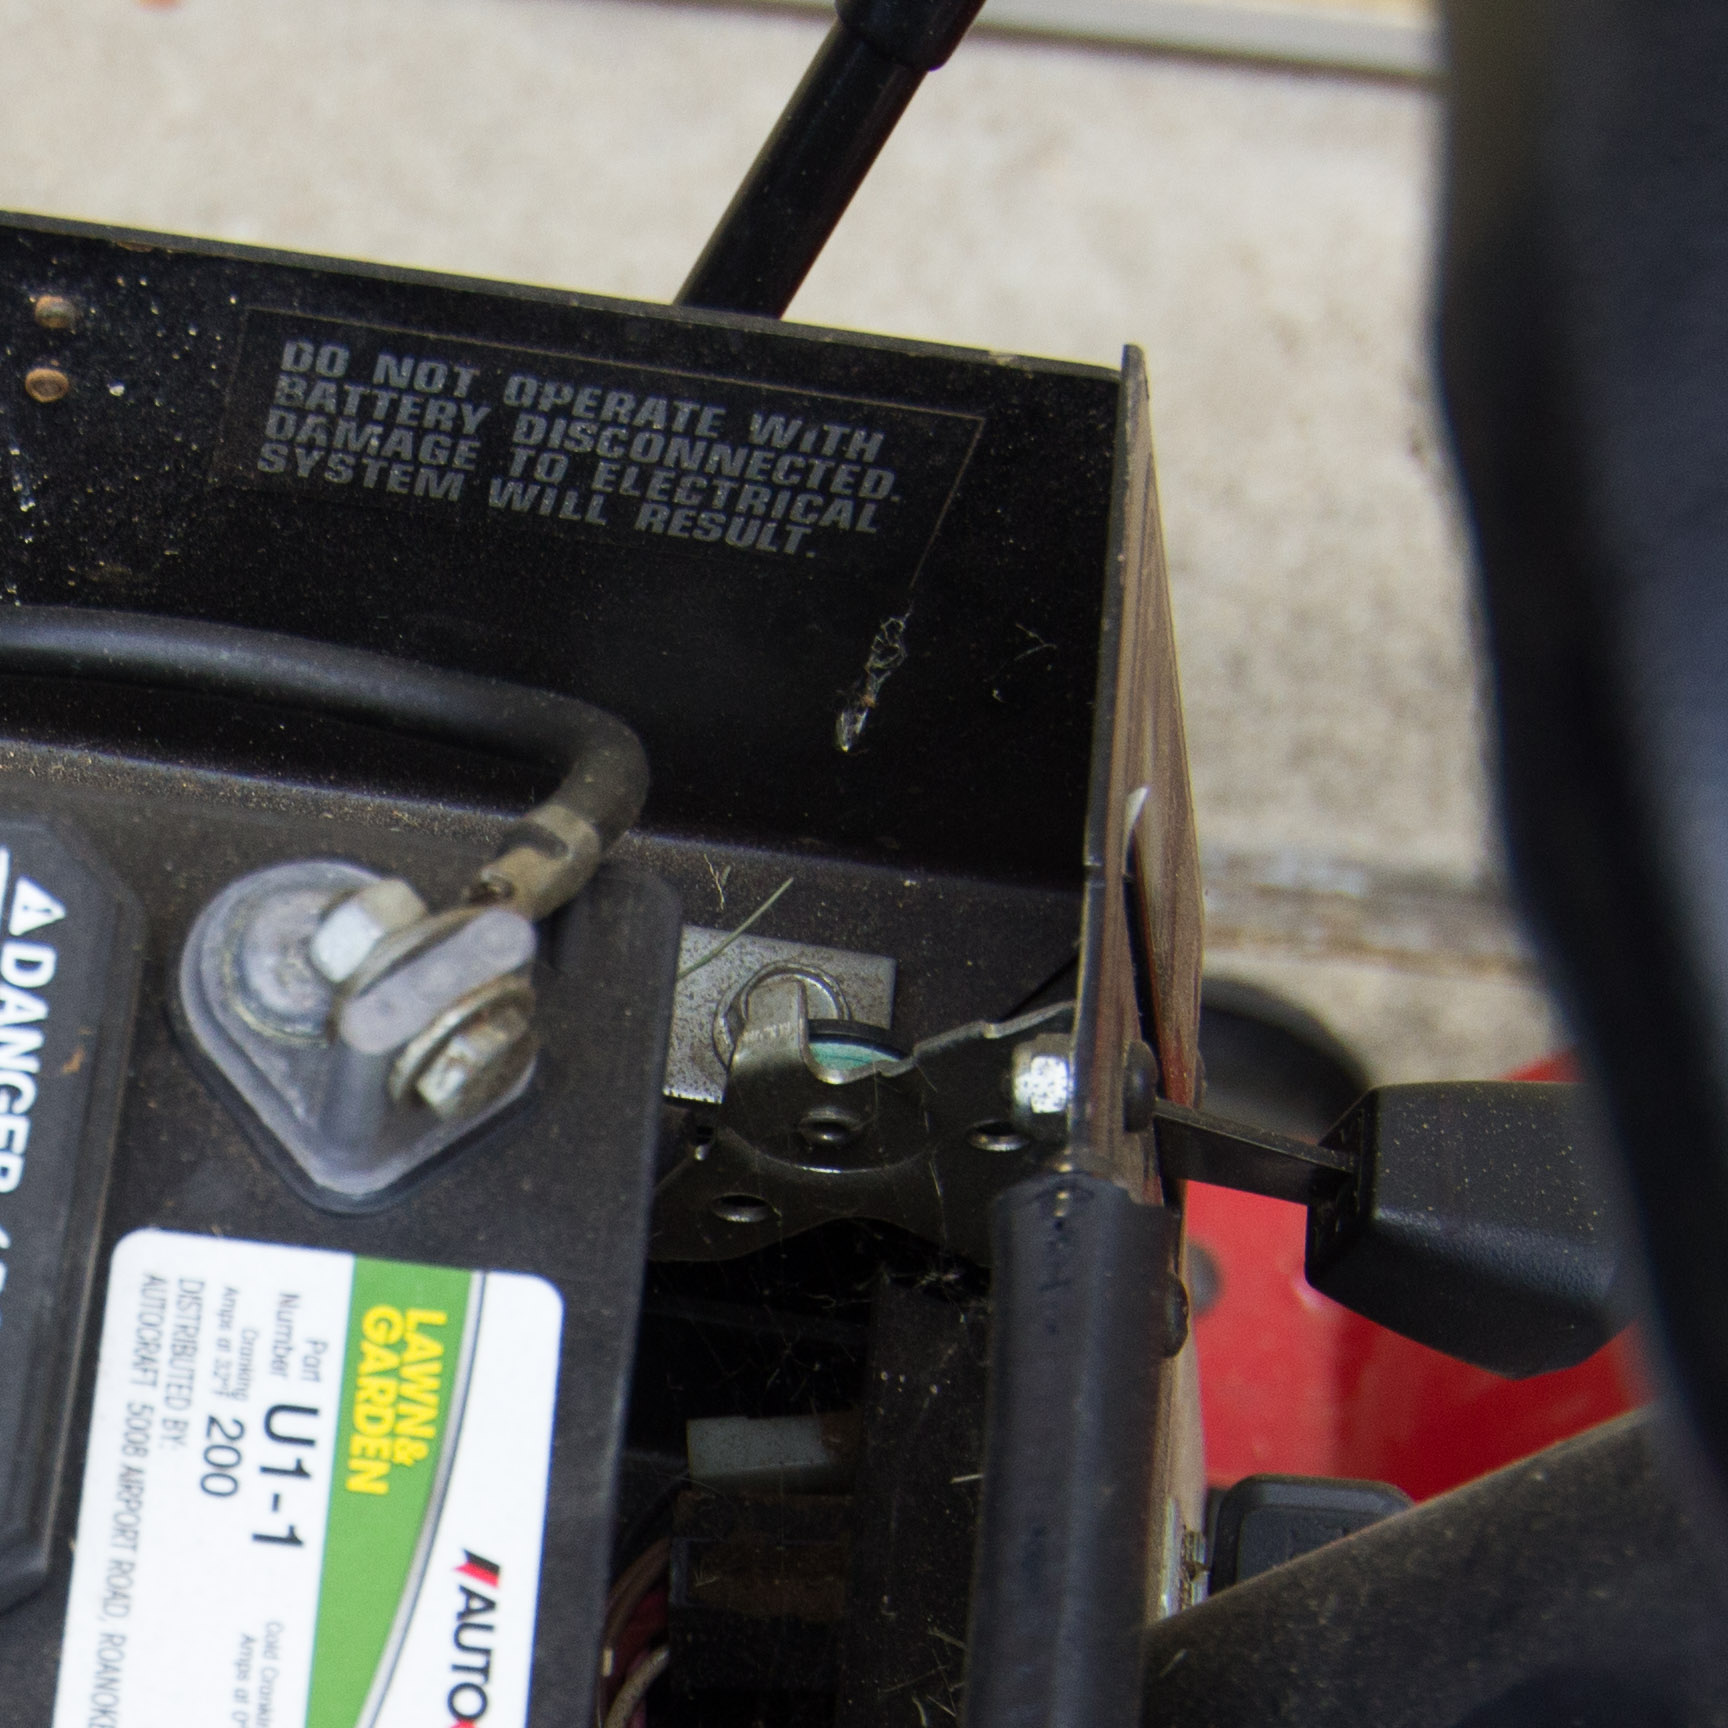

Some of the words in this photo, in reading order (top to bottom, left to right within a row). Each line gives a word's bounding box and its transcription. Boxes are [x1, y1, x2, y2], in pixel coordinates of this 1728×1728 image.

[274, 375, 491, 434] BATTERY
[512, 412, 903, 501] DISCONNECTED.
[281, 341, 350, 379] DO
[373, 353, 481, 400] NOT
[503, 375, 730, 439] OPERATE
[750, 412, 886, 461] WITH
[257, 442, 467, 501] SYSTEM
[487, 478, 609, 526] WILL
[634, 503, 818, 558] RESULT.
[265, 407, 482, 470] DAMAGE
[509, 450, 568, 483] TO
[592, 461, 880, 533] ELECTRICAL
[132, 1273, 167, 1387] AUTOCRAFT
[163, 1278, 205, 1410] DISTRIBUTED
[269, 1291, 300, 1377] Number
[300, 1338, 329, 1383] Part
[120, 1401, 154, 1458] 5008
[347, 1305, 406, 1493] GARDEN
[198, 1414, 246, 1498] 200
[251, 1402, 319, 1547] U1-1
[112, 1463, 145, 1551] AIRPORT
[96, 1559, 136, 1624] ROAD,
[261, 1619, 284, 1661] Cold
[232, 1632, 258, 1682] Amps
